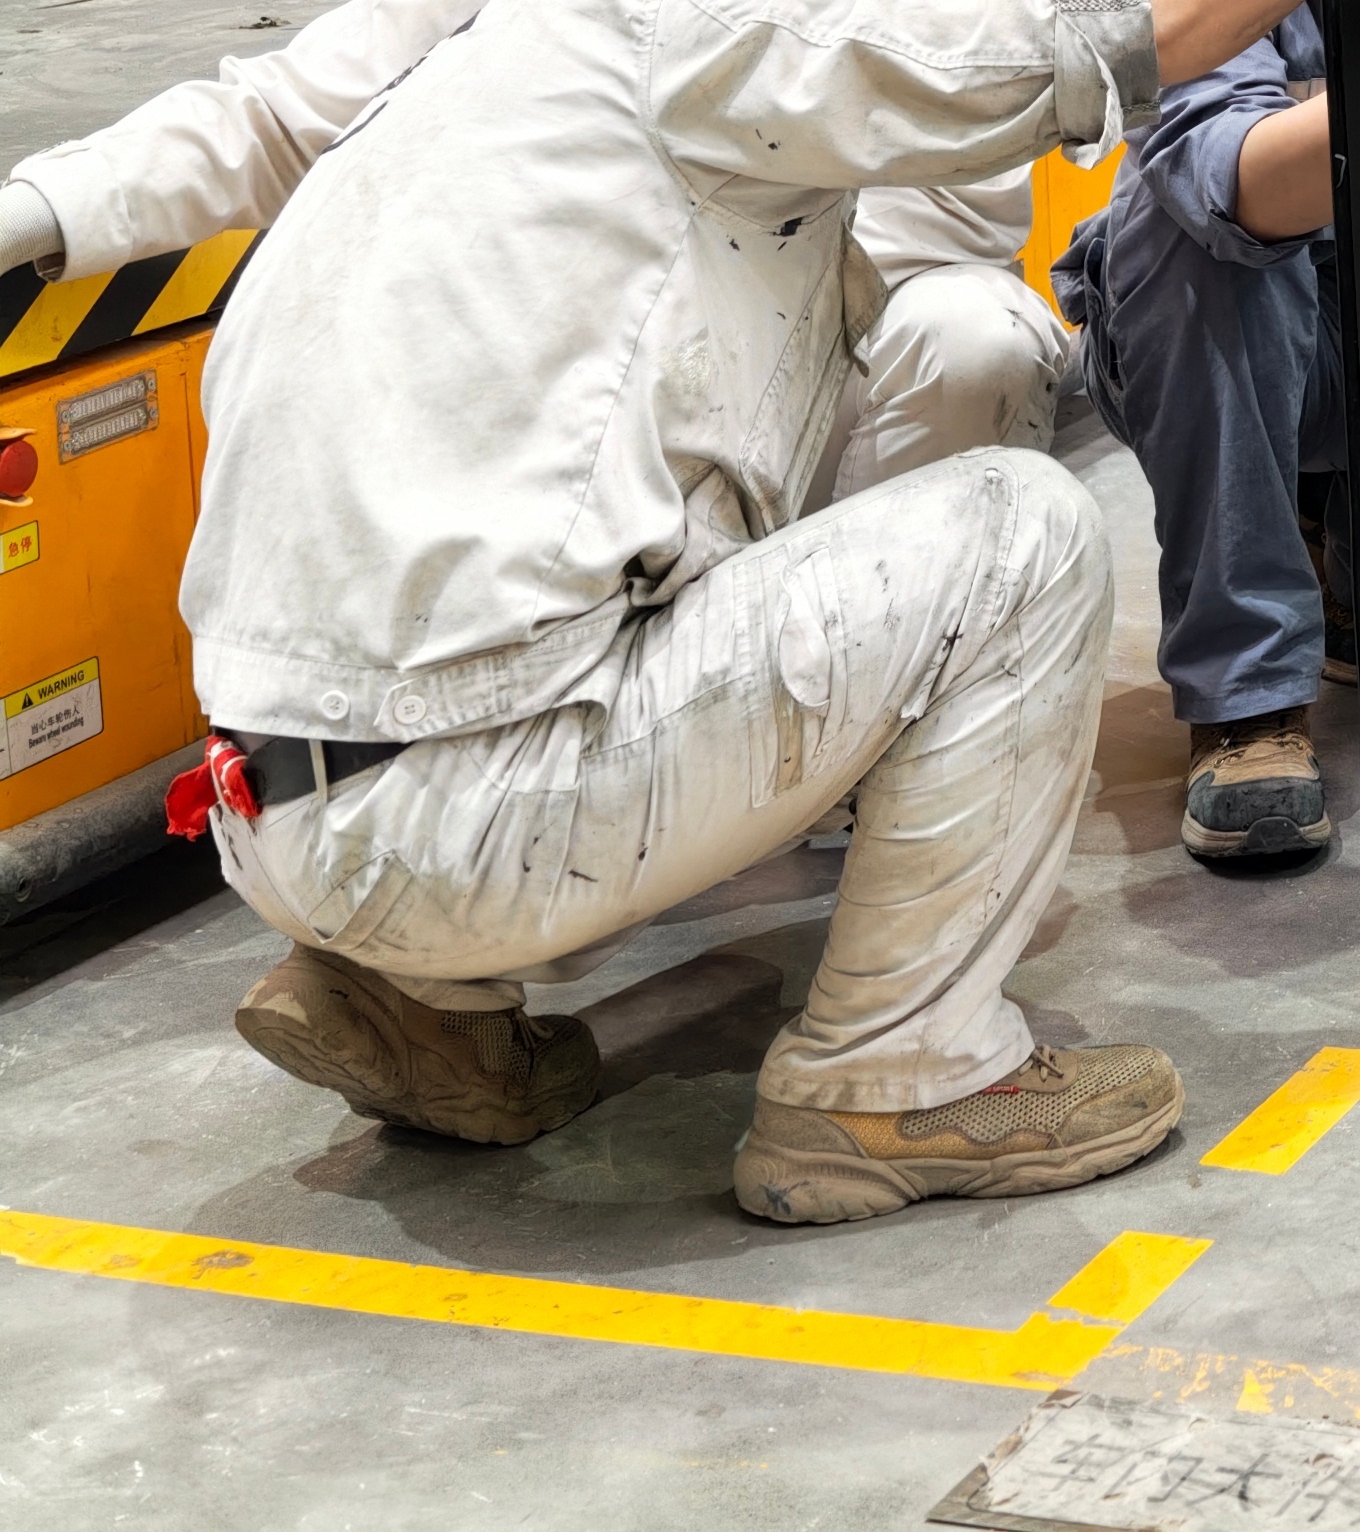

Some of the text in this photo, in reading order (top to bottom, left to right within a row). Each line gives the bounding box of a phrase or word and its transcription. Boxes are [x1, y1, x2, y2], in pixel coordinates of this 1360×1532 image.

[8, 535, 33, 558] 急停
[38, 670, 85, 699] WARNING
[31, 705, 80, 735] 当心车轮伤人
